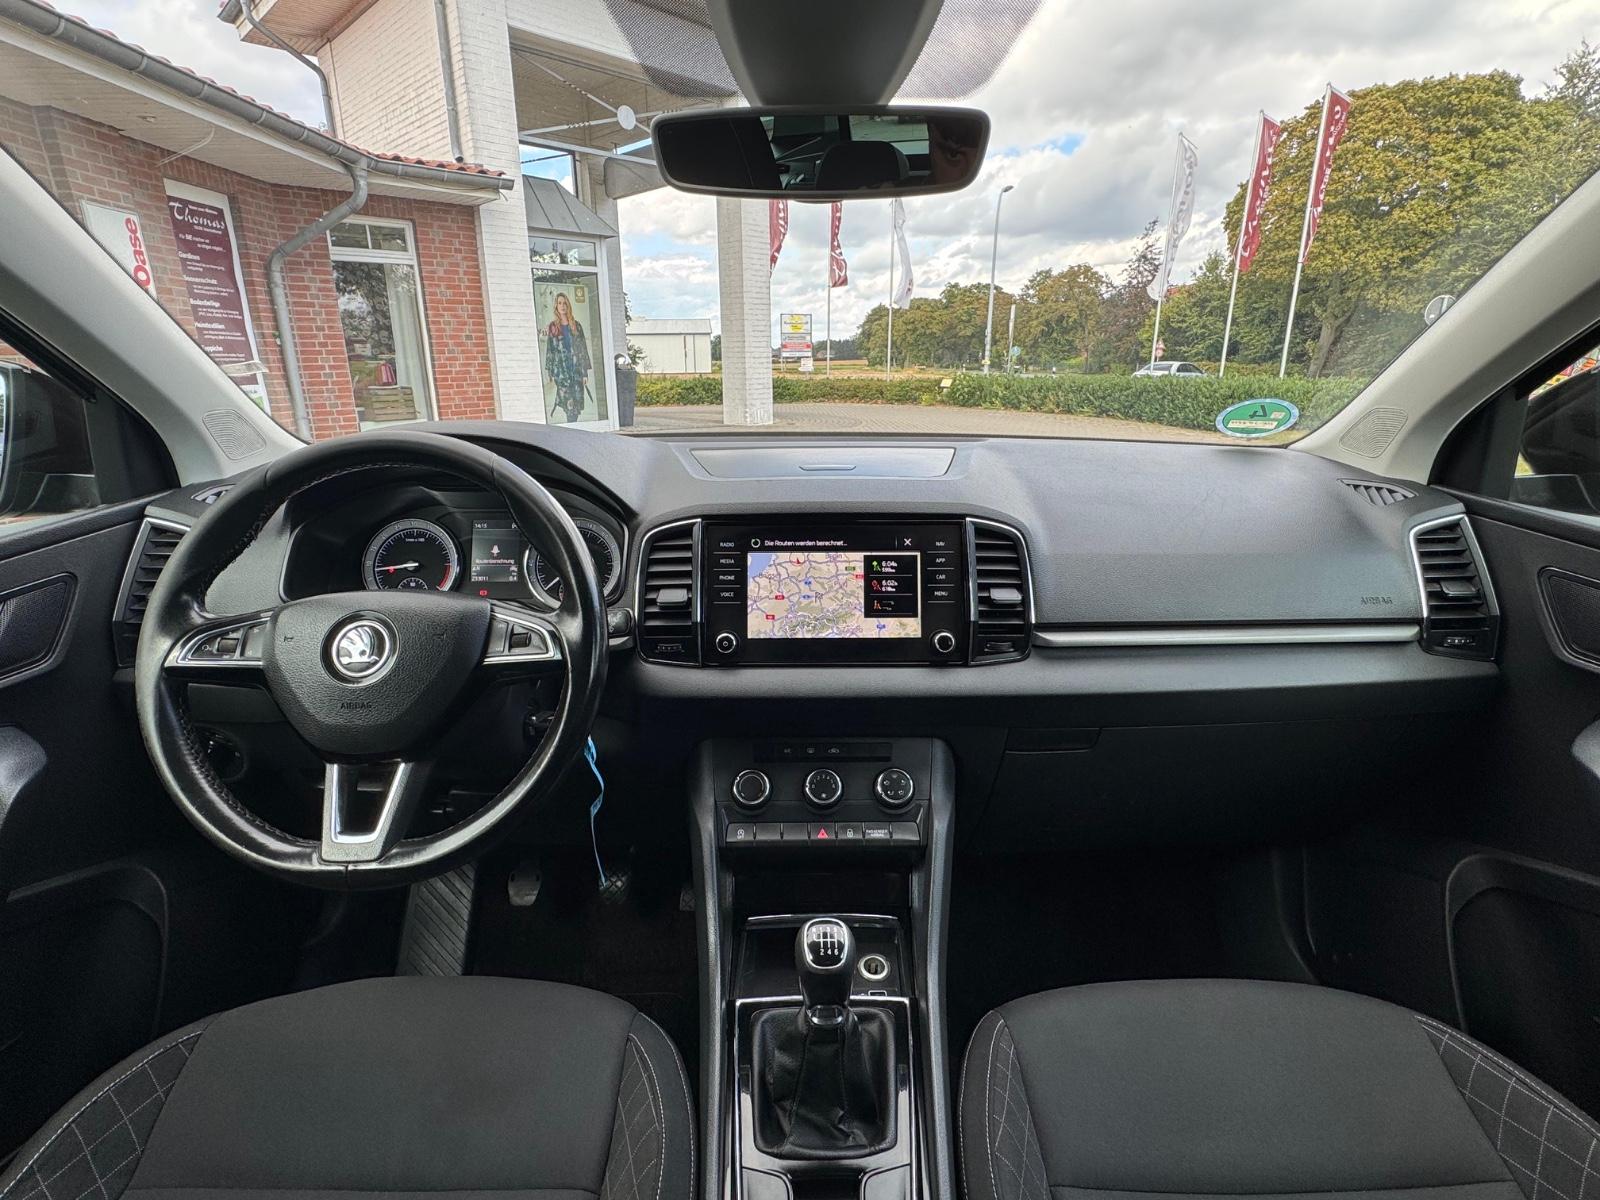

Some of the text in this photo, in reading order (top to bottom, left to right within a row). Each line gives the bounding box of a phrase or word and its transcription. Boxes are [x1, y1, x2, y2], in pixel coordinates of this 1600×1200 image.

[168, 201, 225, 230] Thomas
[124, 217, 151, 287] Oase
[1360, 596, 1394, 606] AIRBAG
[340, 701, 373, 710] AIRBAG
[819, 948, 825, 956] 2
[833, 948, 839, 956] 6
